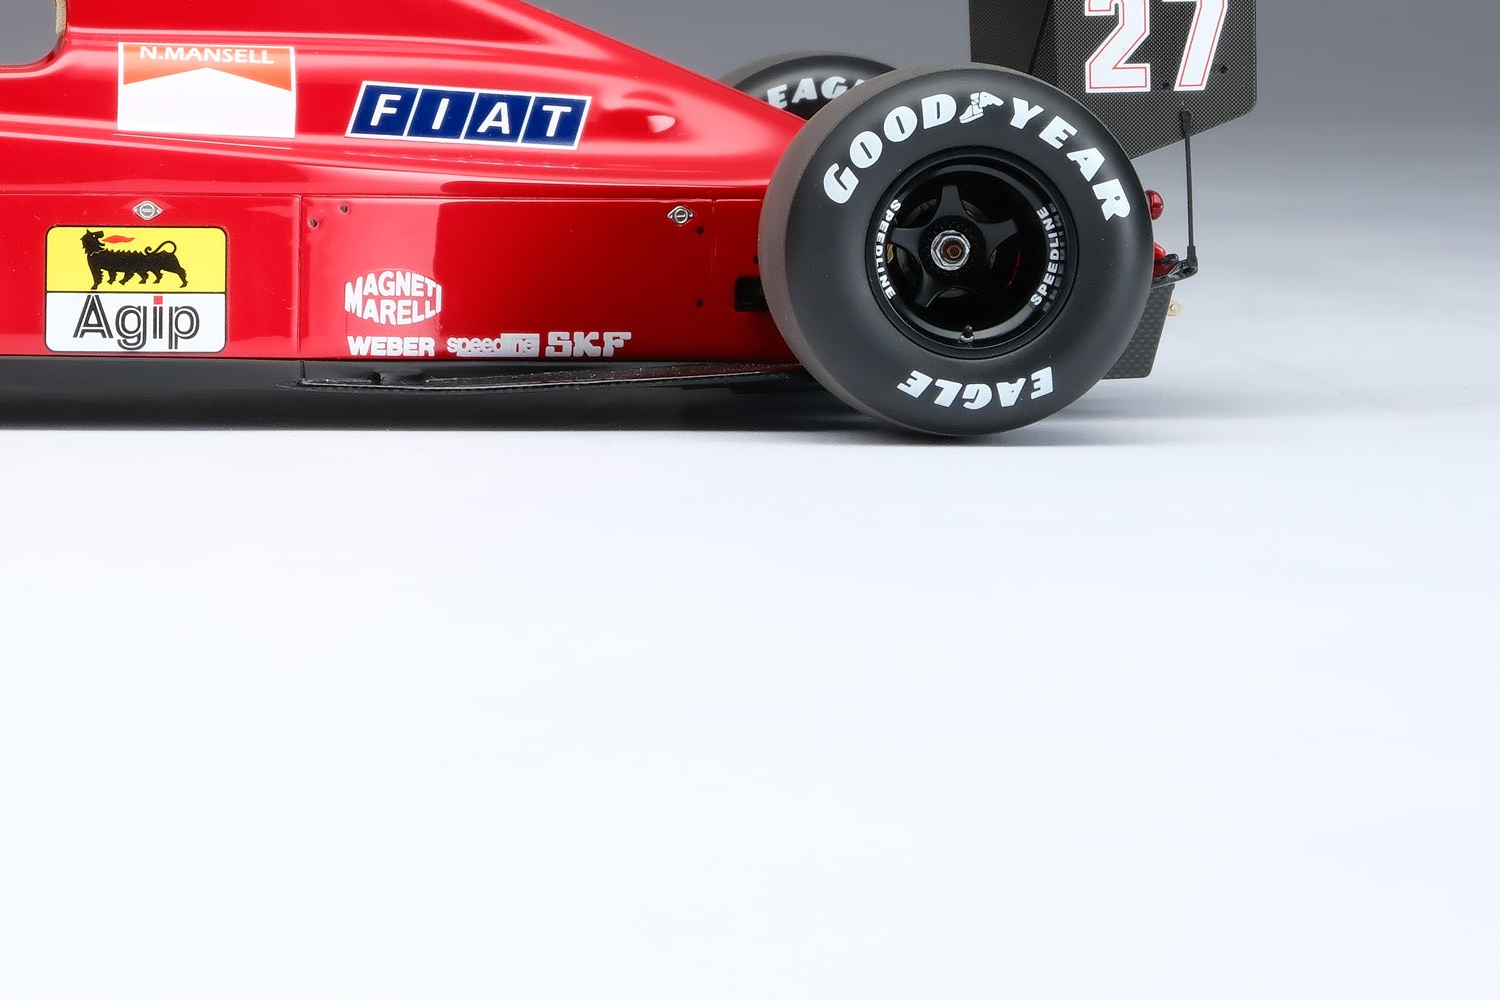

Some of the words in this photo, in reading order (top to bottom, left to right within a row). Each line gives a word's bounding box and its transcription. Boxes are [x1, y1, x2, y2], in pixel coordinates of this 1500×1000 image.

[139, 45, 274, 65] N.MANSELL
[766, 75, 866, 110] EAG
[369, 93, 573, 138] FIAT
[823, 91, 1132, 222] GOODYEAR
[875, 199, 902, 299] SPEEDLINE
[1030, 206, 1060, 306] SPEEDLINE
[344, 270, 442, 310] MAGNETI
[72, 294, 201, 351] Agip
[545, 331, 632, 357] SKF
[346, 335, 436, 357] WEBER
[896, 366, 1054, 410] EAGLE
